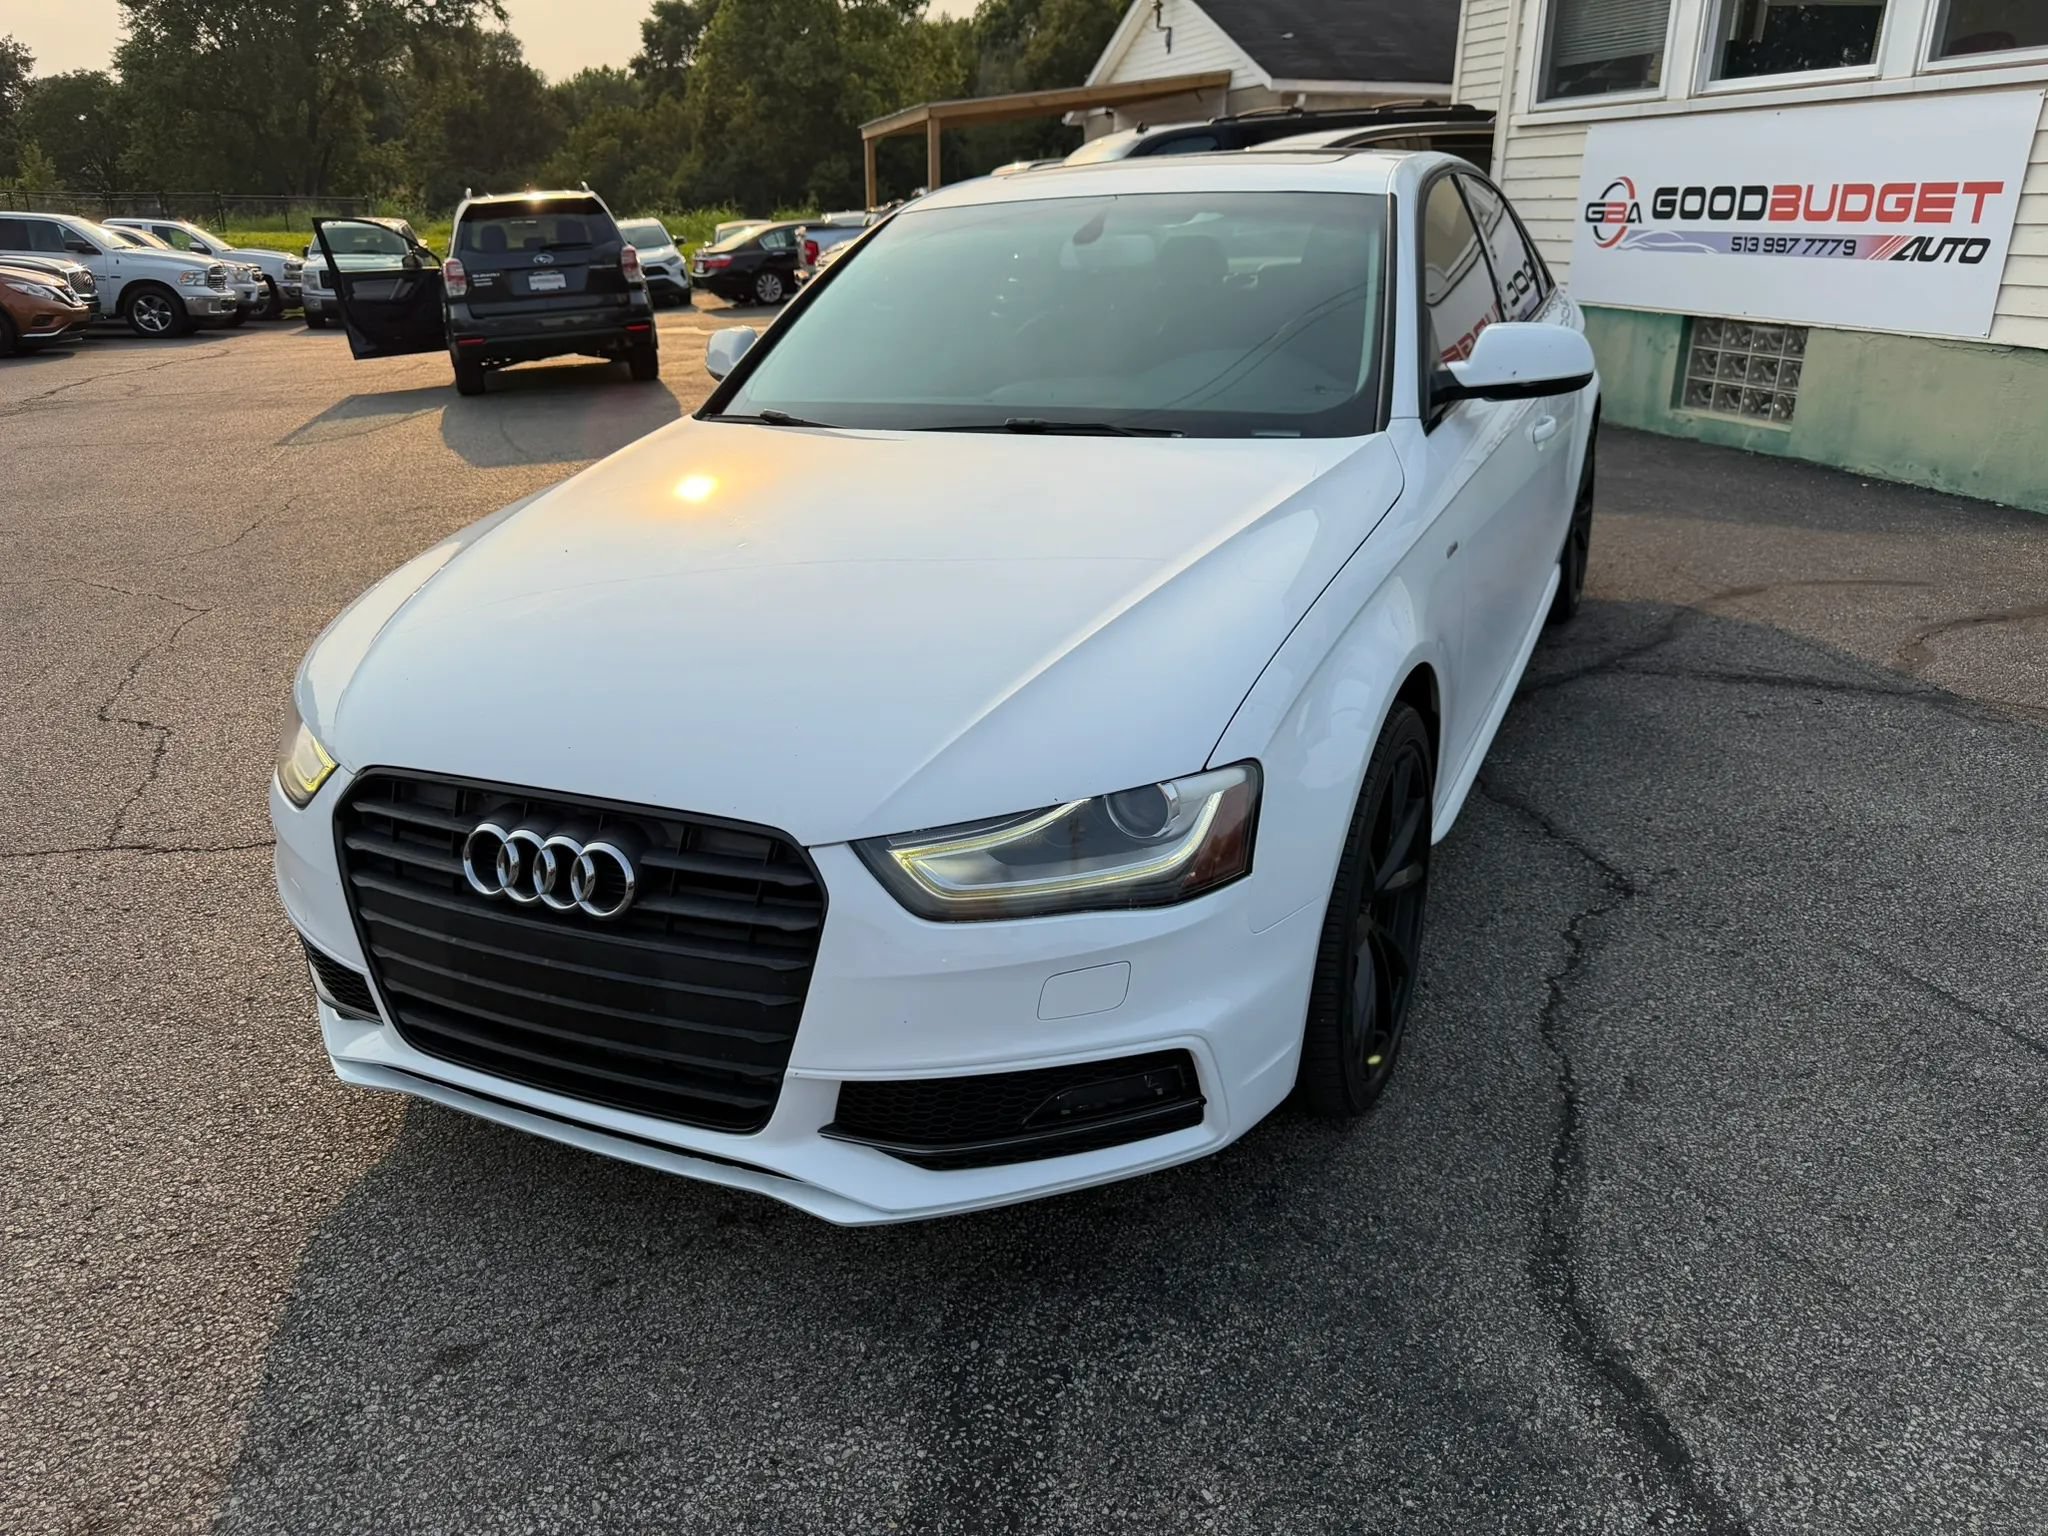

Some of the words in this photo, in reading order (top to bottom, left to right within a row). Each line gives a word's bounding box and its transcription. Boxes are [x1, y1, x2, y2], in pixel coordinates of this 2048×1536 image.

[1585, 202, 1642, 223] GBA
[1652, 181, 2004, 224] GOODBUDGET
[1731, 236, 1759, 252] 513
[1763, 238, 1800, 255] 997
[1803, 239, 1857, 256] 7779
[1889, 236, 1991, 264] AUTO
